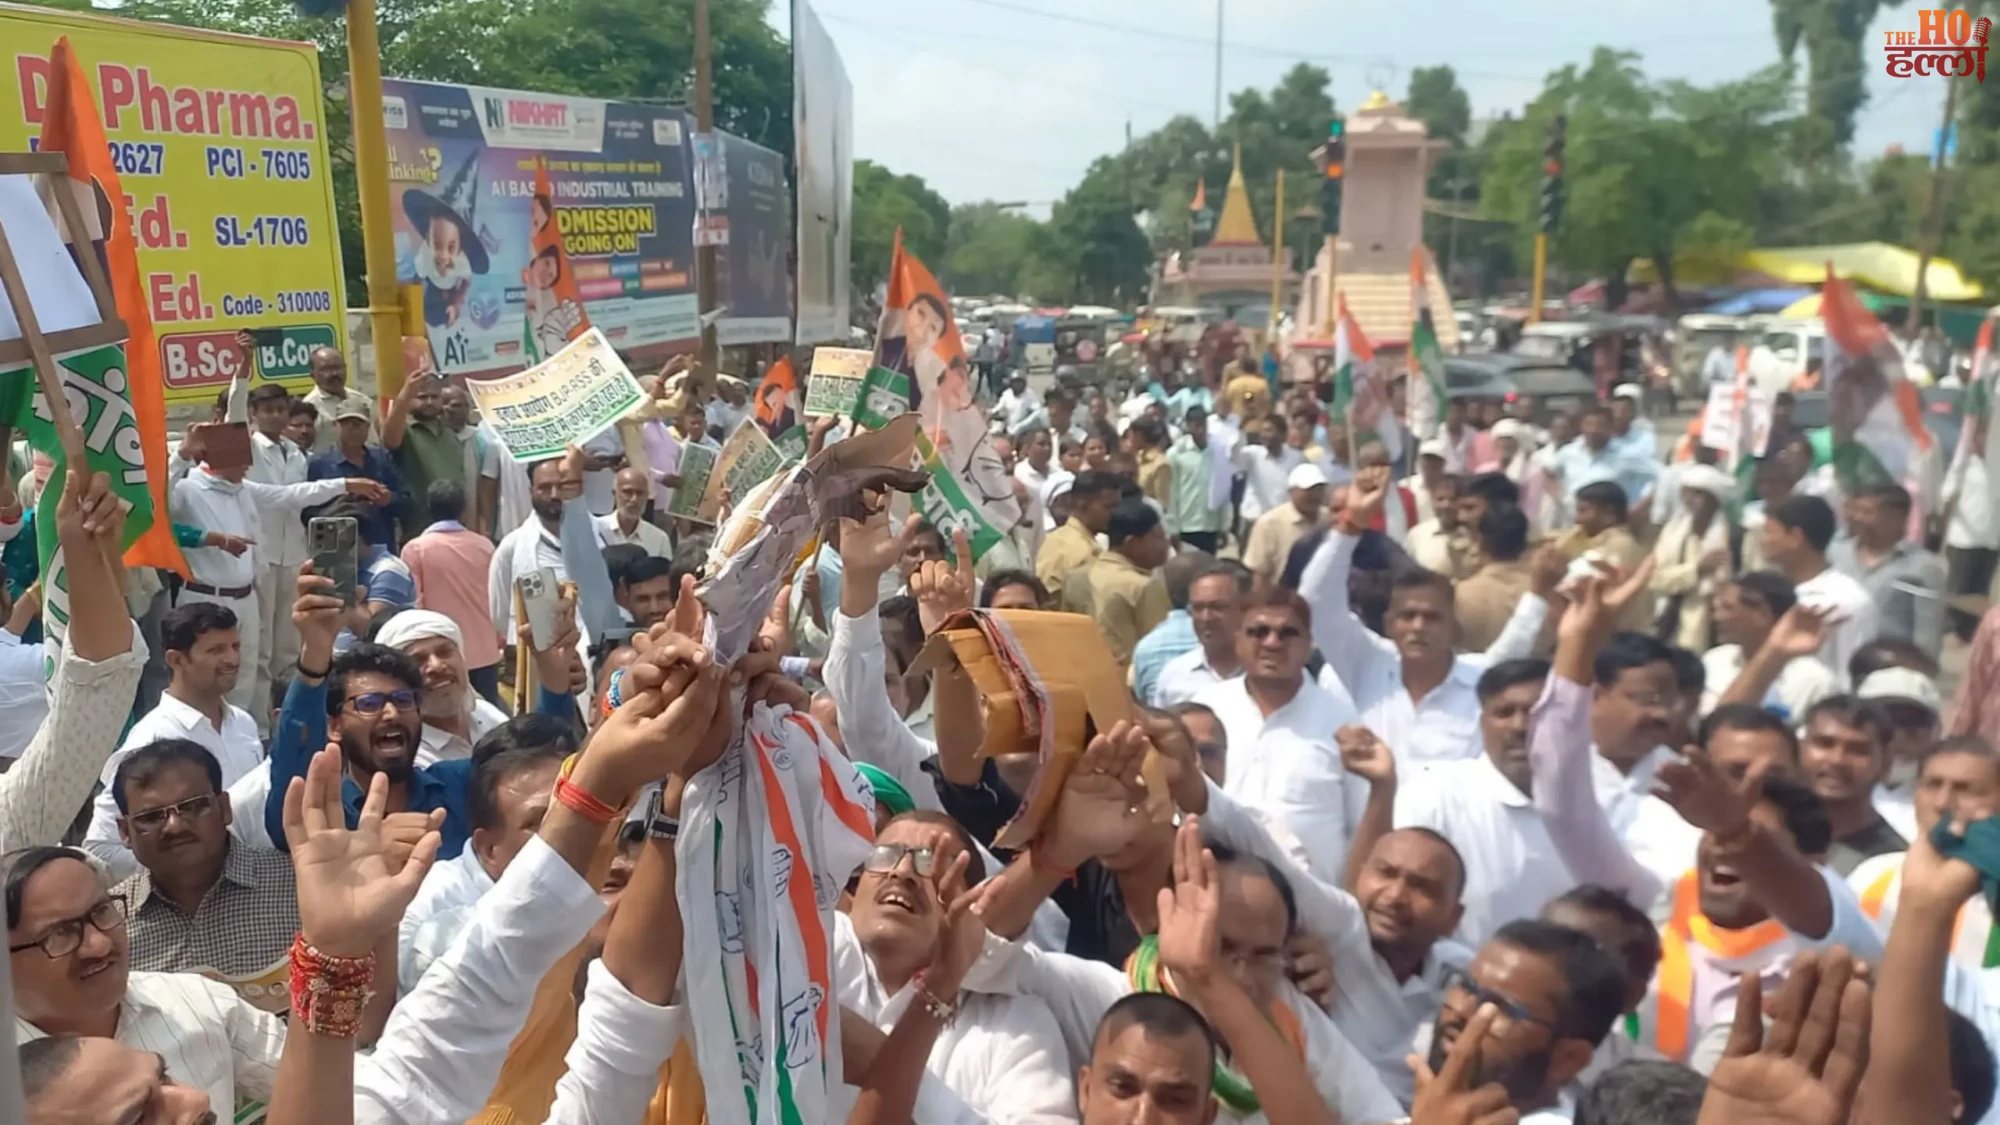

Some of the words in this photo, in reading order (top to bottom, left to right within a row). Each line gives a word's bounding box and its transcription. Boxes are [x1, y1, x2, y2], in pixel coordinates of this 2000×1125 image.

[97, 61, 315, 141] Pharma.
[207, 147, 243, 178] PCI
[262, 149, 310, 180] 7605
[491, 181, 506, 197] AI
[509, 181, 554, 198] BASD
[558, 181, 630, 199] INDUSTRIAL
[632, 181, 684, 198] TRAINING
[215, 216, 308, 247] SL-1706
[555, 206, 654, 236] DMISSION
[564, 234, 612, 254] GOING
[615, 233, 636, 251] ON
[150, 273, 214, 322] Ed.
[223, 294, 262, 316] Code
[278, 290, 331, 313] 310008
